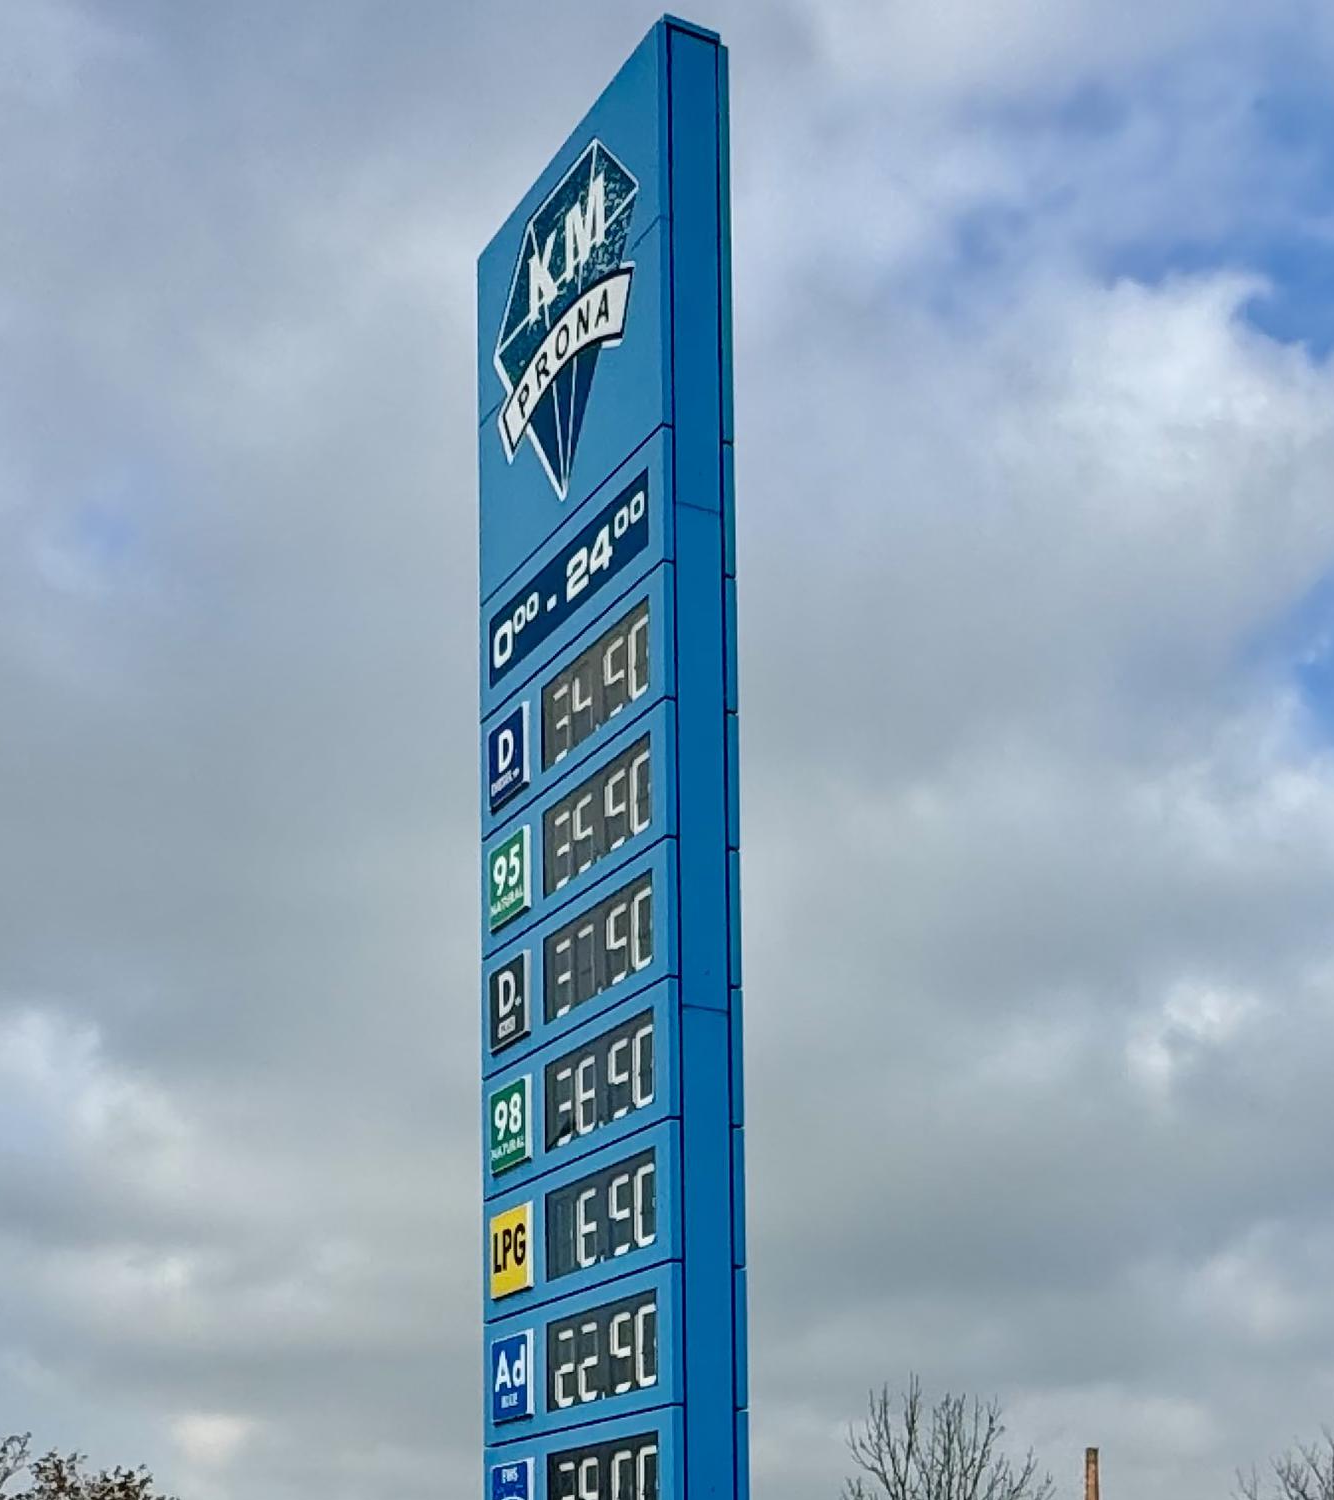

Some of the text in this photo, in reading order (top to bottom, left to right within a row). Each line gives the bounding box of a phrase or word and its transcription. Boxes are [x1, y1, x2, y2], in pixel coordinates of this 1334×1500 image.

[528, 172, 605, 328] KM
[516, 287, 611, 419] PRONA
[498, 728, 514, 774] D
[493, 843, 520, 897] 95
[494, 1092, 522, 1141] 98
[493, 1222, 526, 1274] LPG
[494, 1343, 526, 1393] Ad
